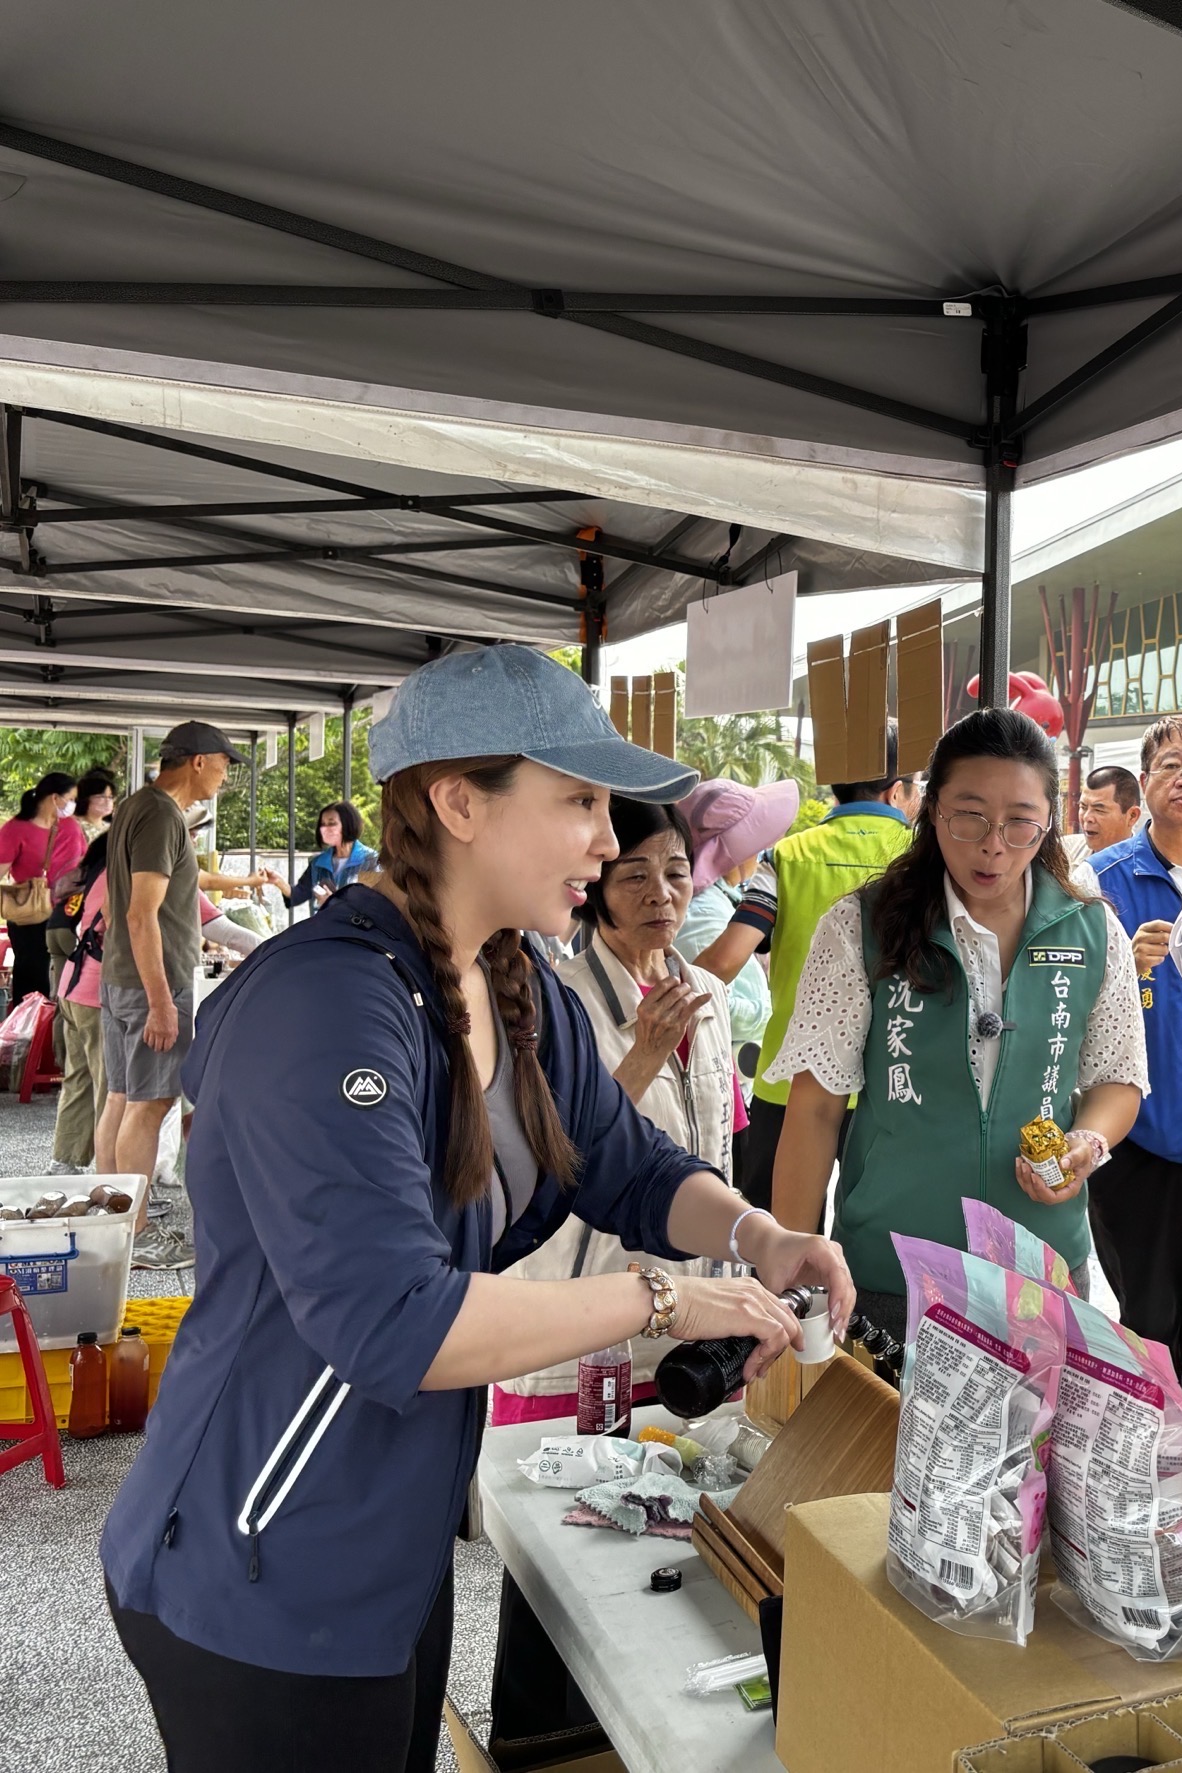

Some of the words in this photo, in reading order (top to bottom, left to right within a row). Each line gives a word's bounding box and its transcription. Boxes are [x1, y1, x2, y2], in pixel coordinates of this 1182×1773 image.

[1046, 951, 1083, 963] DPP
[886, 973, 924, 1107] 沈家鳳
[1040, 970, 1071, 1121] 台南市議員
